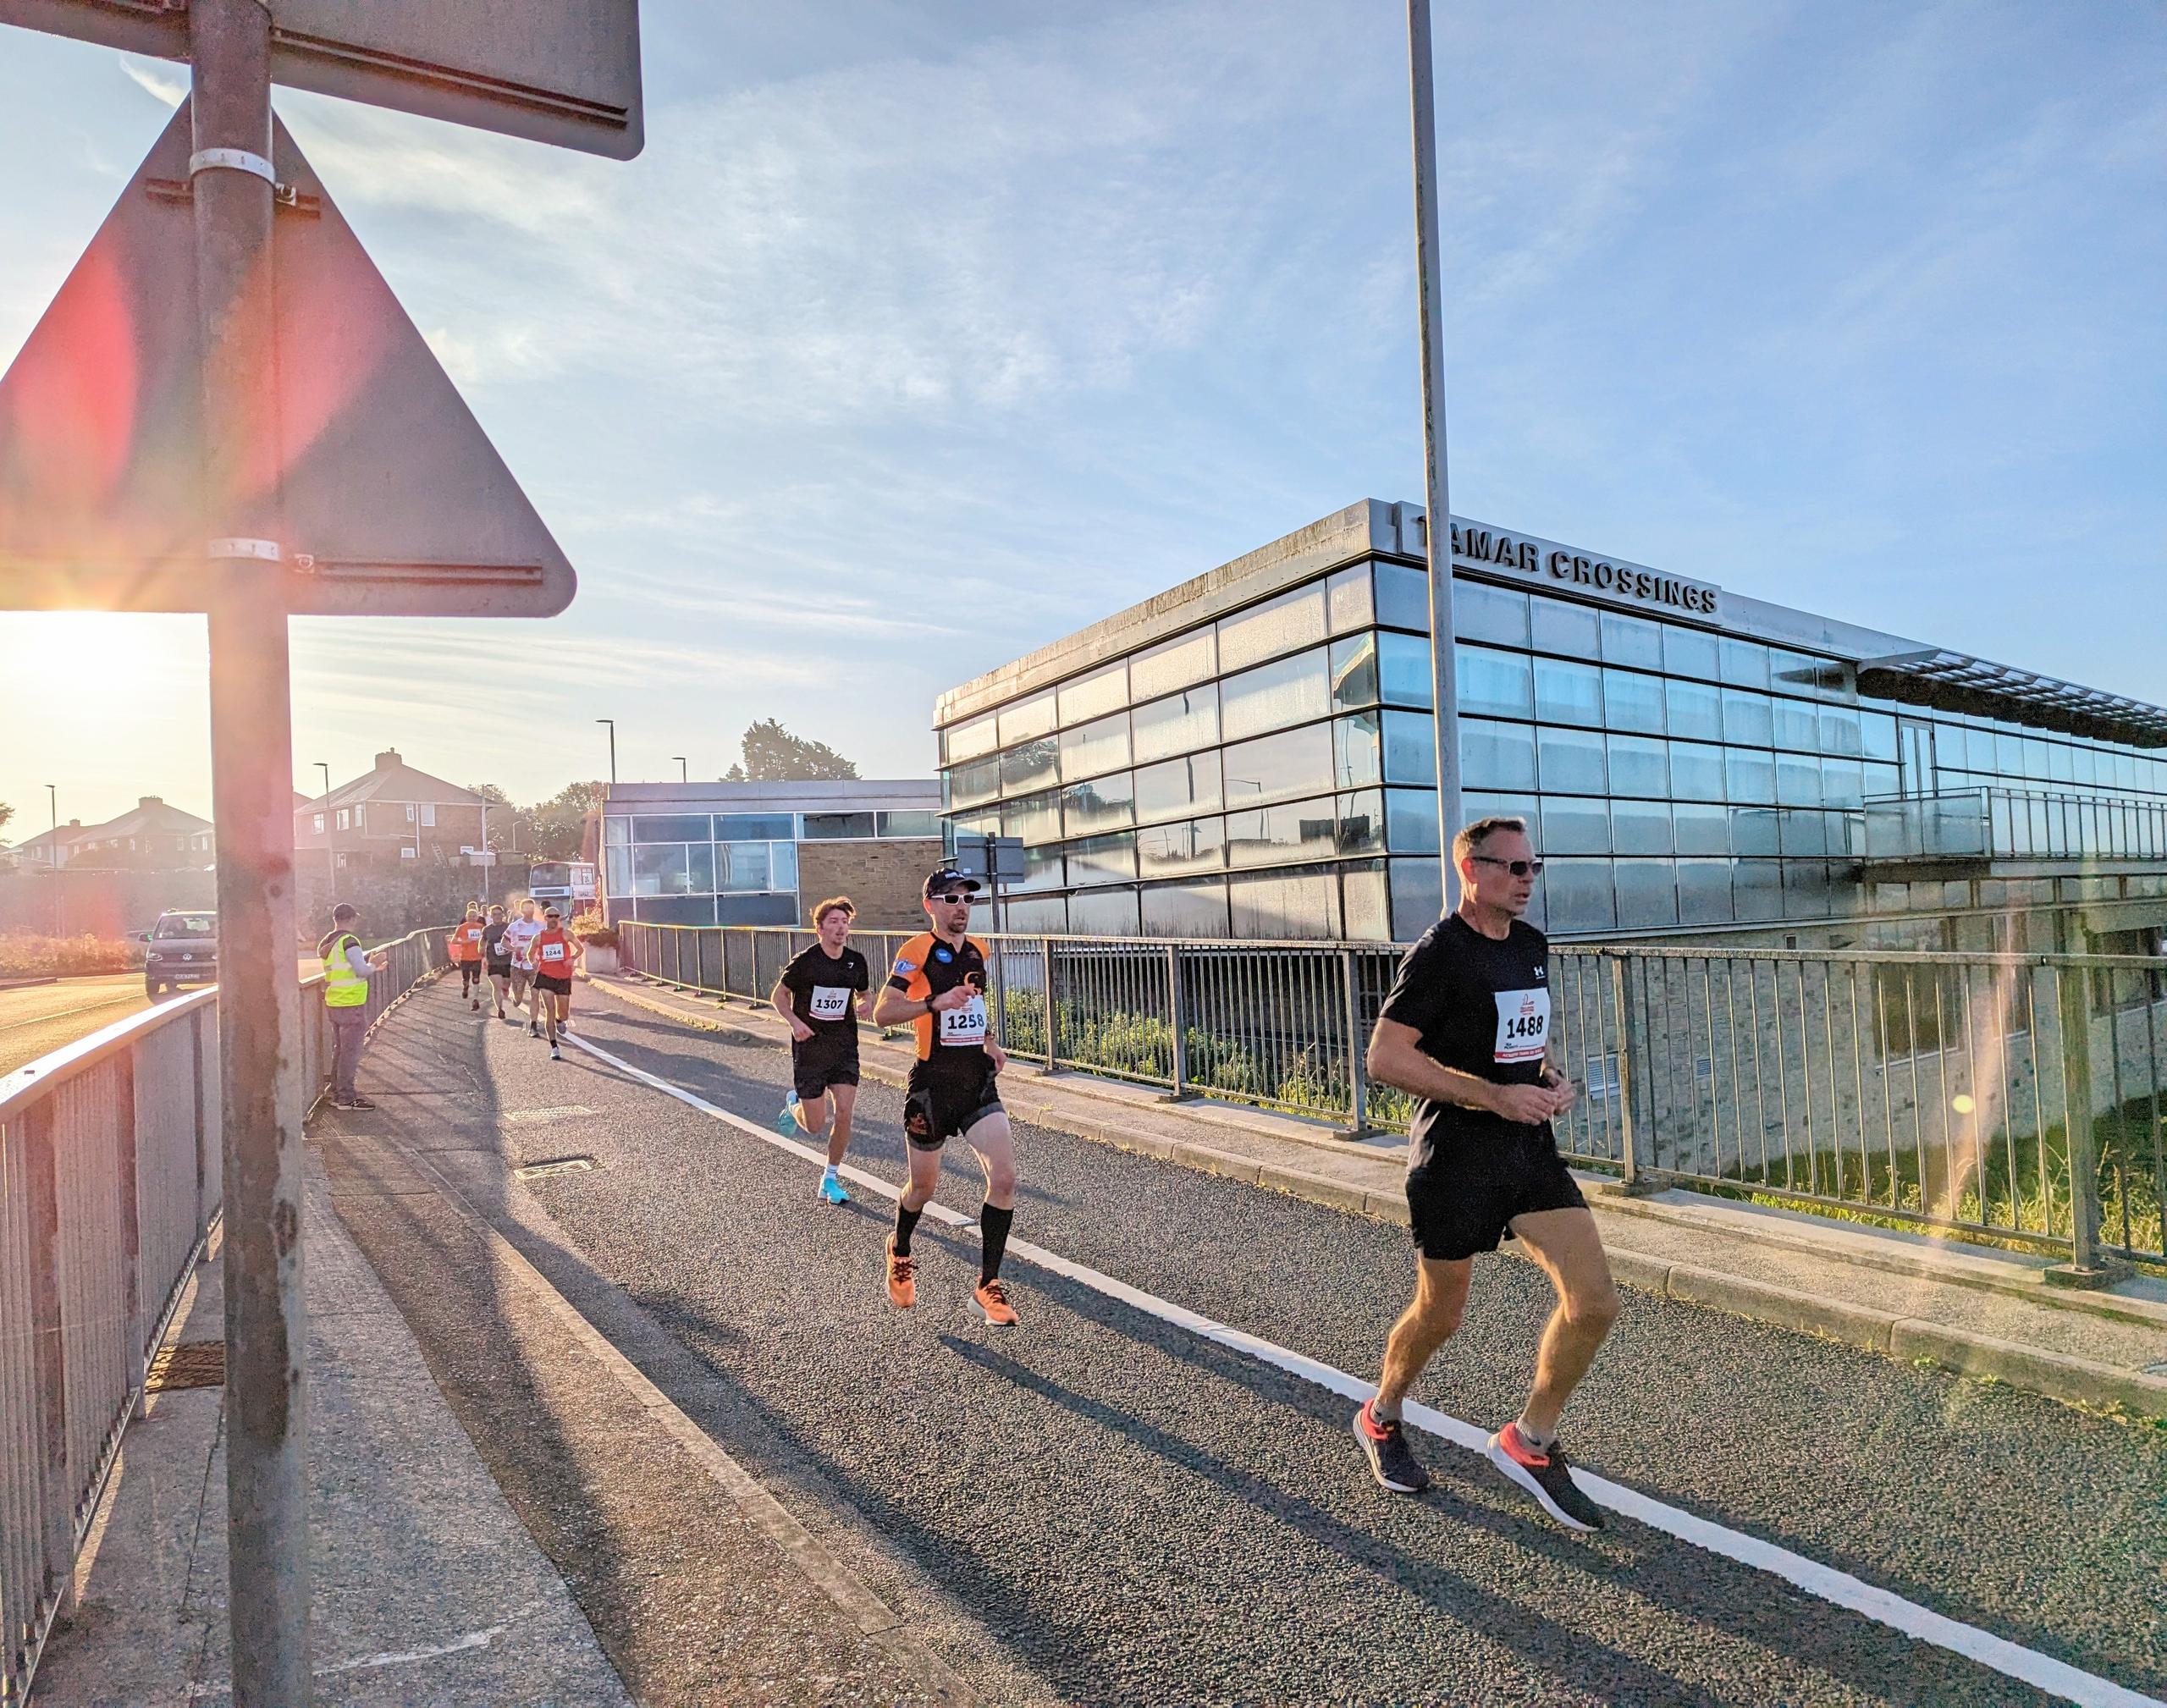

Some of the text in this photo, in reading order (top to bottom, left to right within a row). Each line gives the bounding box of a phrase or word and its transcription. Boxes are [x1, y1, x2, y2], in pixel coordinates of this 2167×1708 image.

[1418, 515, 1717, 613] AMAR CROSSINGS
[815, 999, 844, 1010] 1307
[947, 1013, 984, 1029] 1258
[1507, 1015, 1544, 1039] 1488
